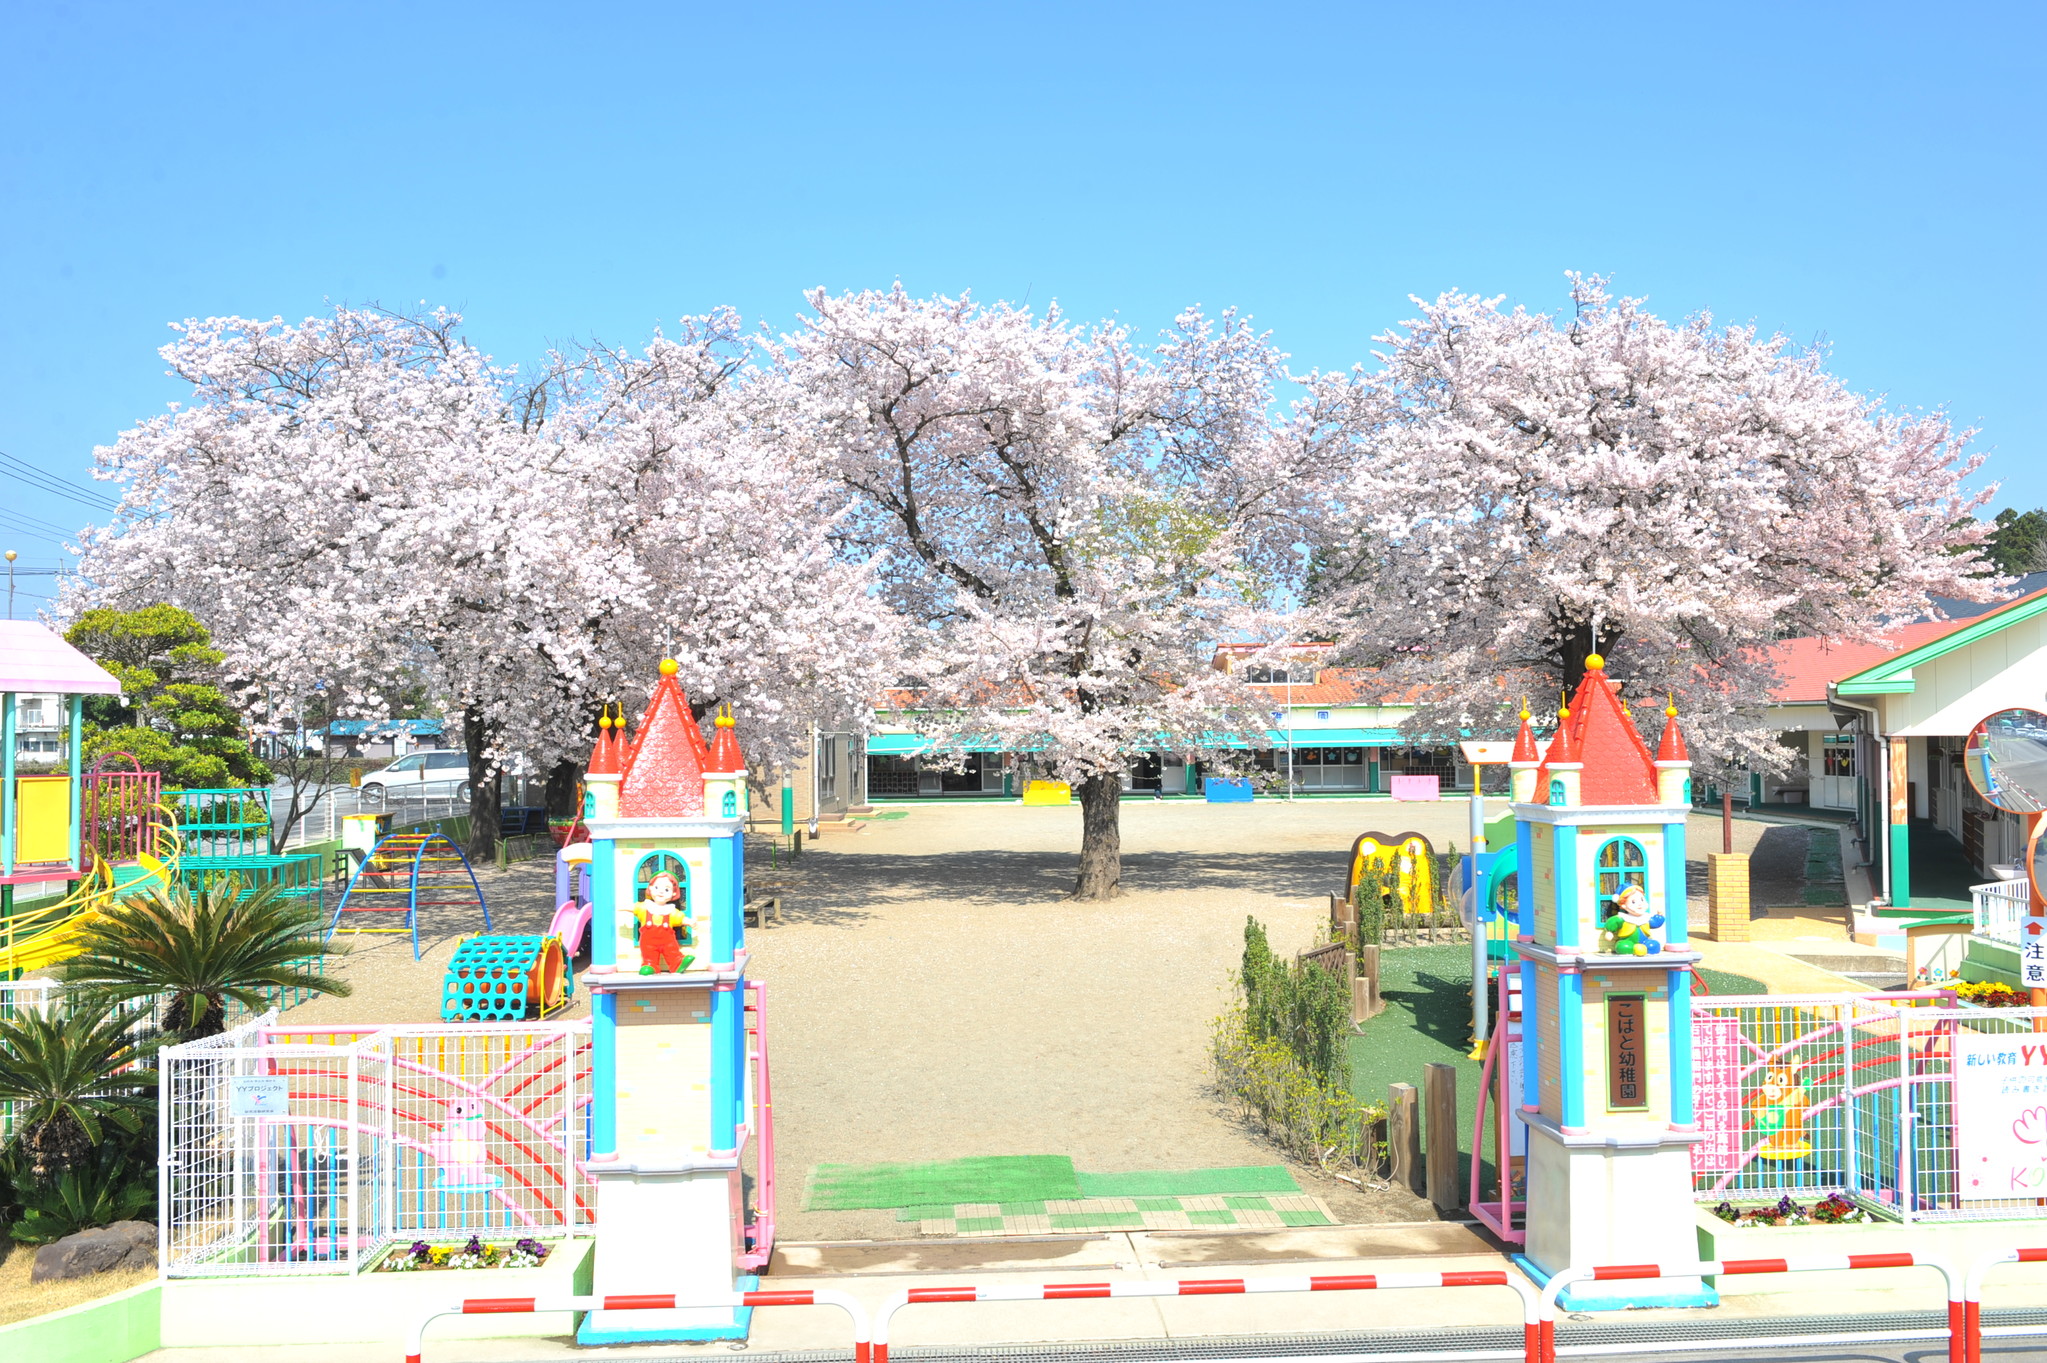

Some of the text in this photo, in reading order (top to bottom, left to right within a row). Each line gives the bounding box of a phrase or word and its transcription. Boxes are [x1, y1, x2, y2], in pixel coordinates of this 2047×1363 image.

[2025, 942, 2045, 981] 注意
[1966, 1052, 2017, 1067] 新しい教育
